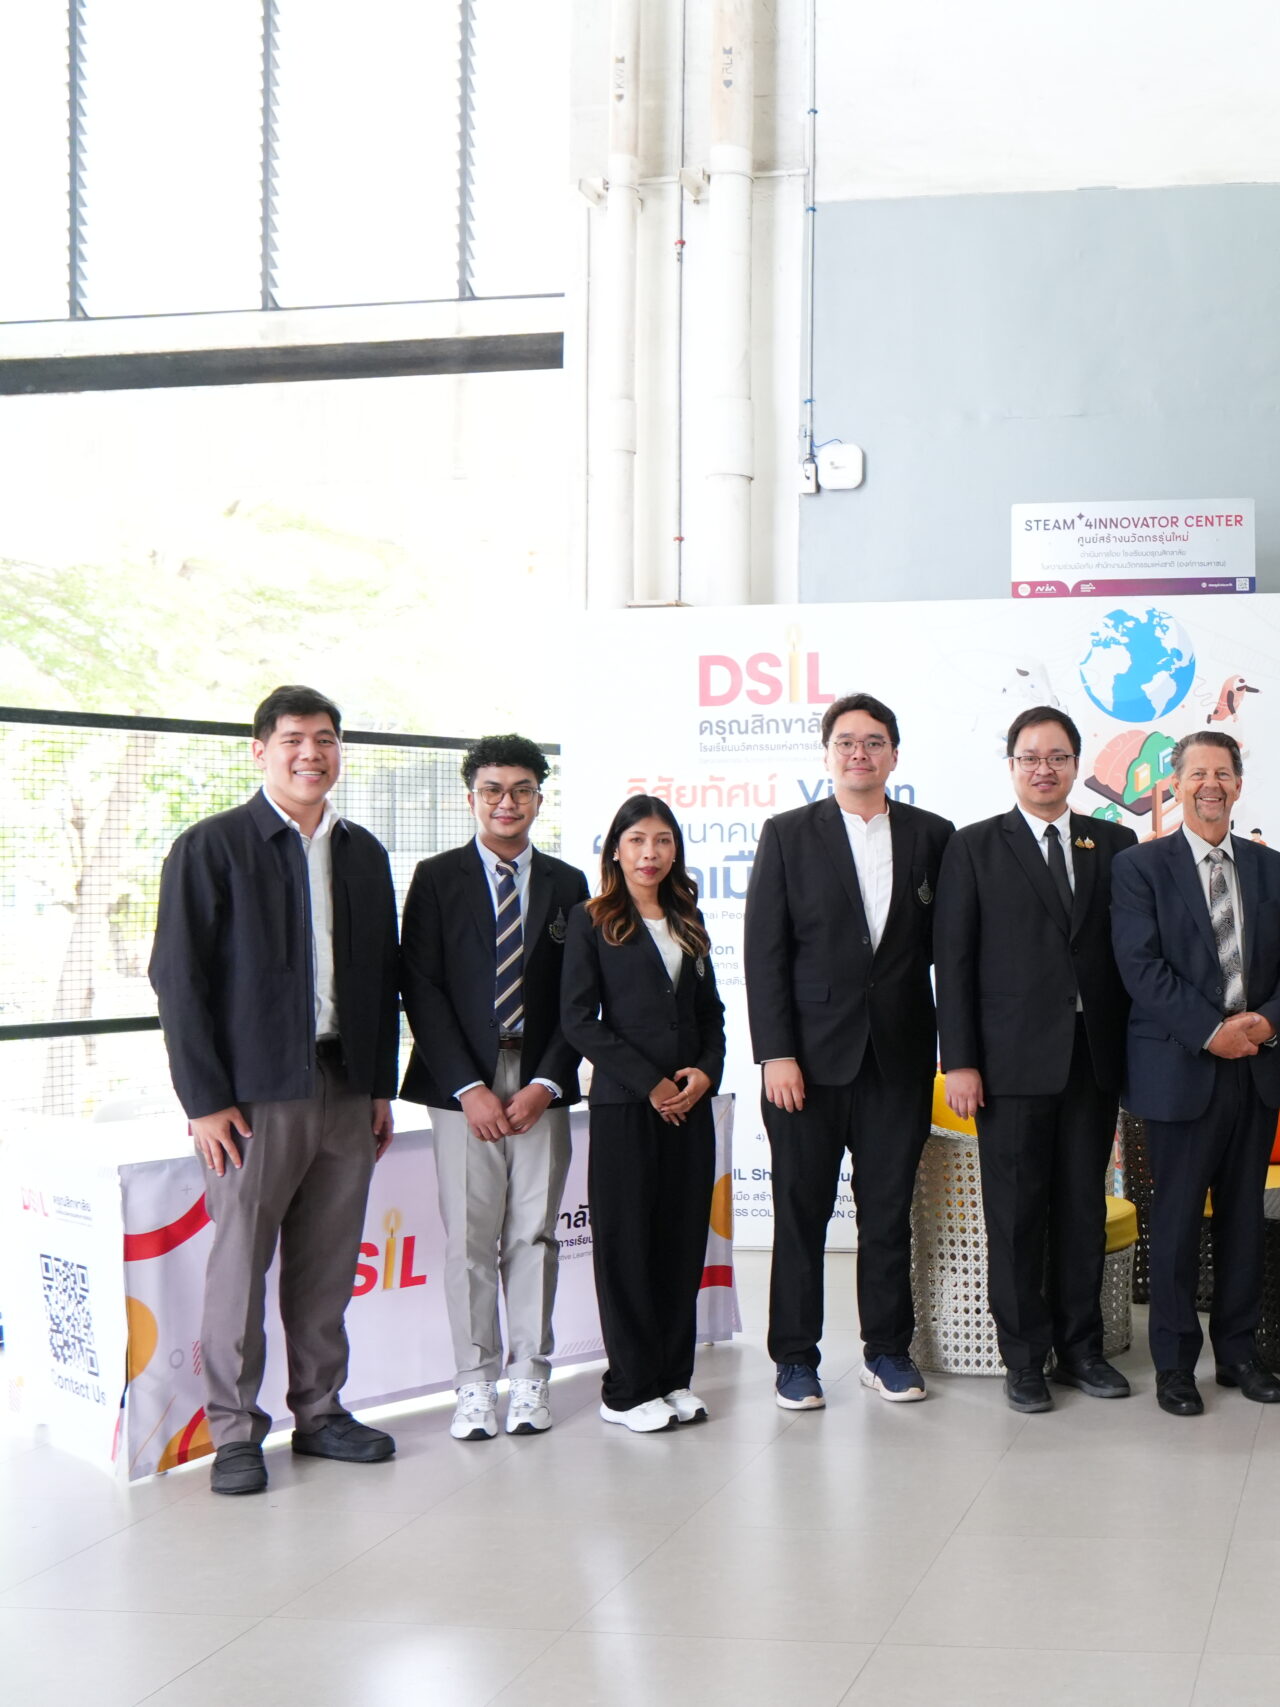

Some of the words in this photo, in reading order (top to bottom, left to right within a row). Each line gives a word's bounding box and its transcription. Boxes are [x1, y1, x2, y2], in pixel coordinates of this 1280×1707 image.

[1024, 519, 1075, 532] STEAM
[1084, 516, 1180, 530] 4INNOVATOR
[1185, 514, 1244, 528] CENTER
[698, 711, 823, 743] ดรุณสิกขาลั
[796, 778, 915, 805] Vin
